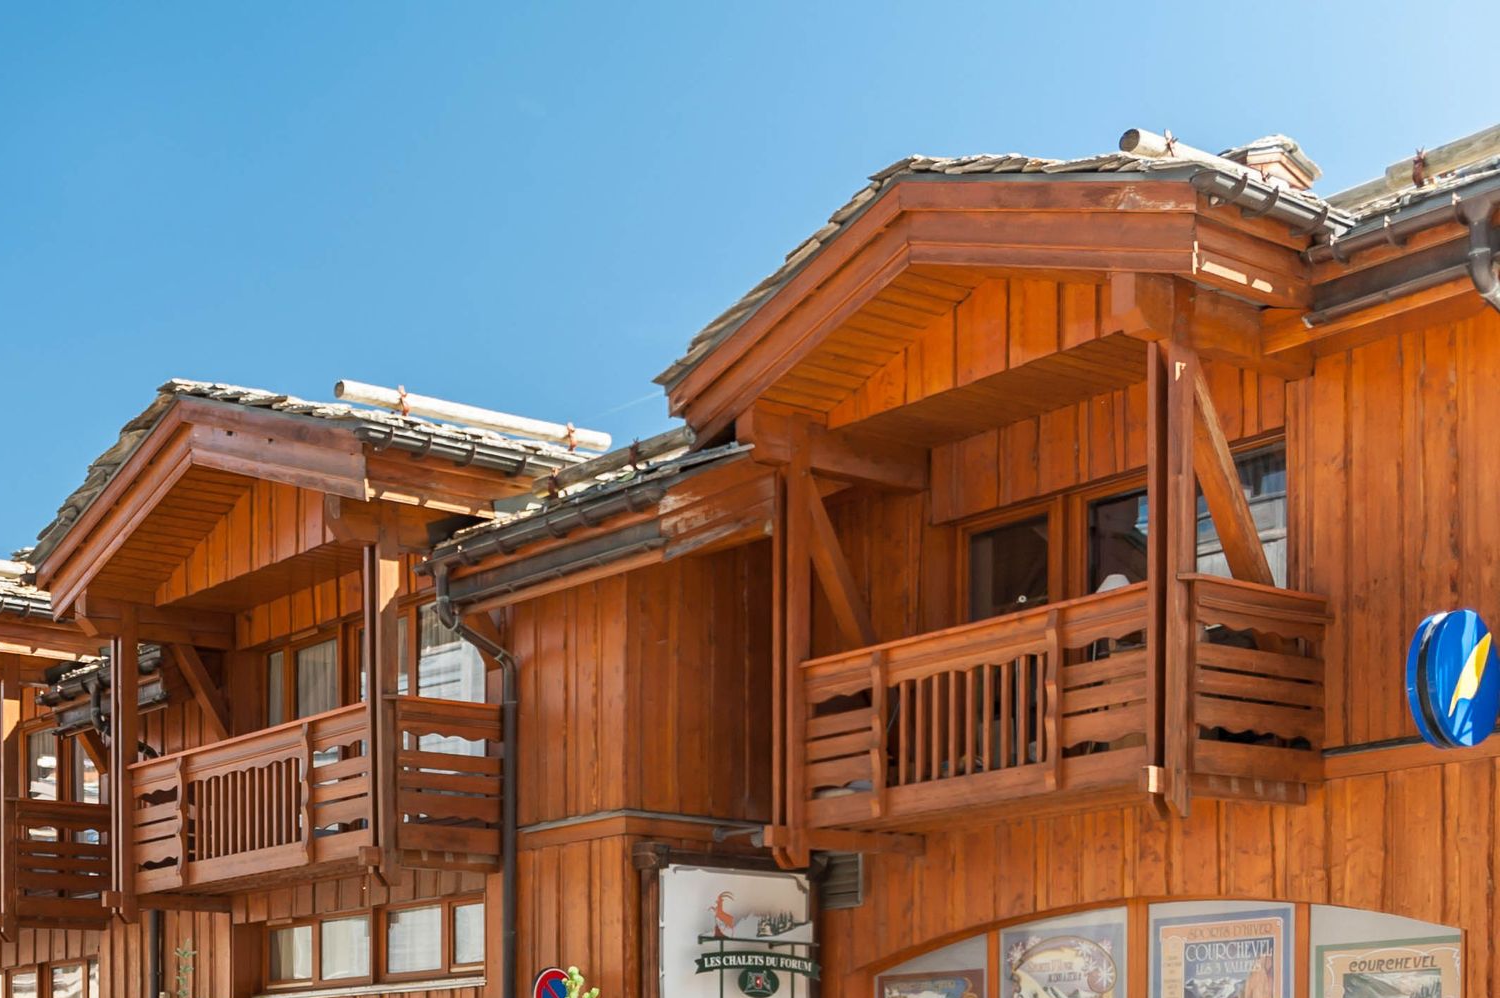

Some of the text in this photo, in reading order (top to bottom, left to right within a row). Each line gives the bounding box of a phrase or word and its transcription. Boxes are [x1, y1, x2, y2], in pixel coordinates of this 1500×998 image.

[1188, 923, 1272, 939] SPORTS D'HIVER
[1186, 940, 1273, 962] COURCHEVEL
[704, 955, 812, 972] LES CHALETS DU FORUM
[1349, 955, 1438, 973] COURCHEVEL
